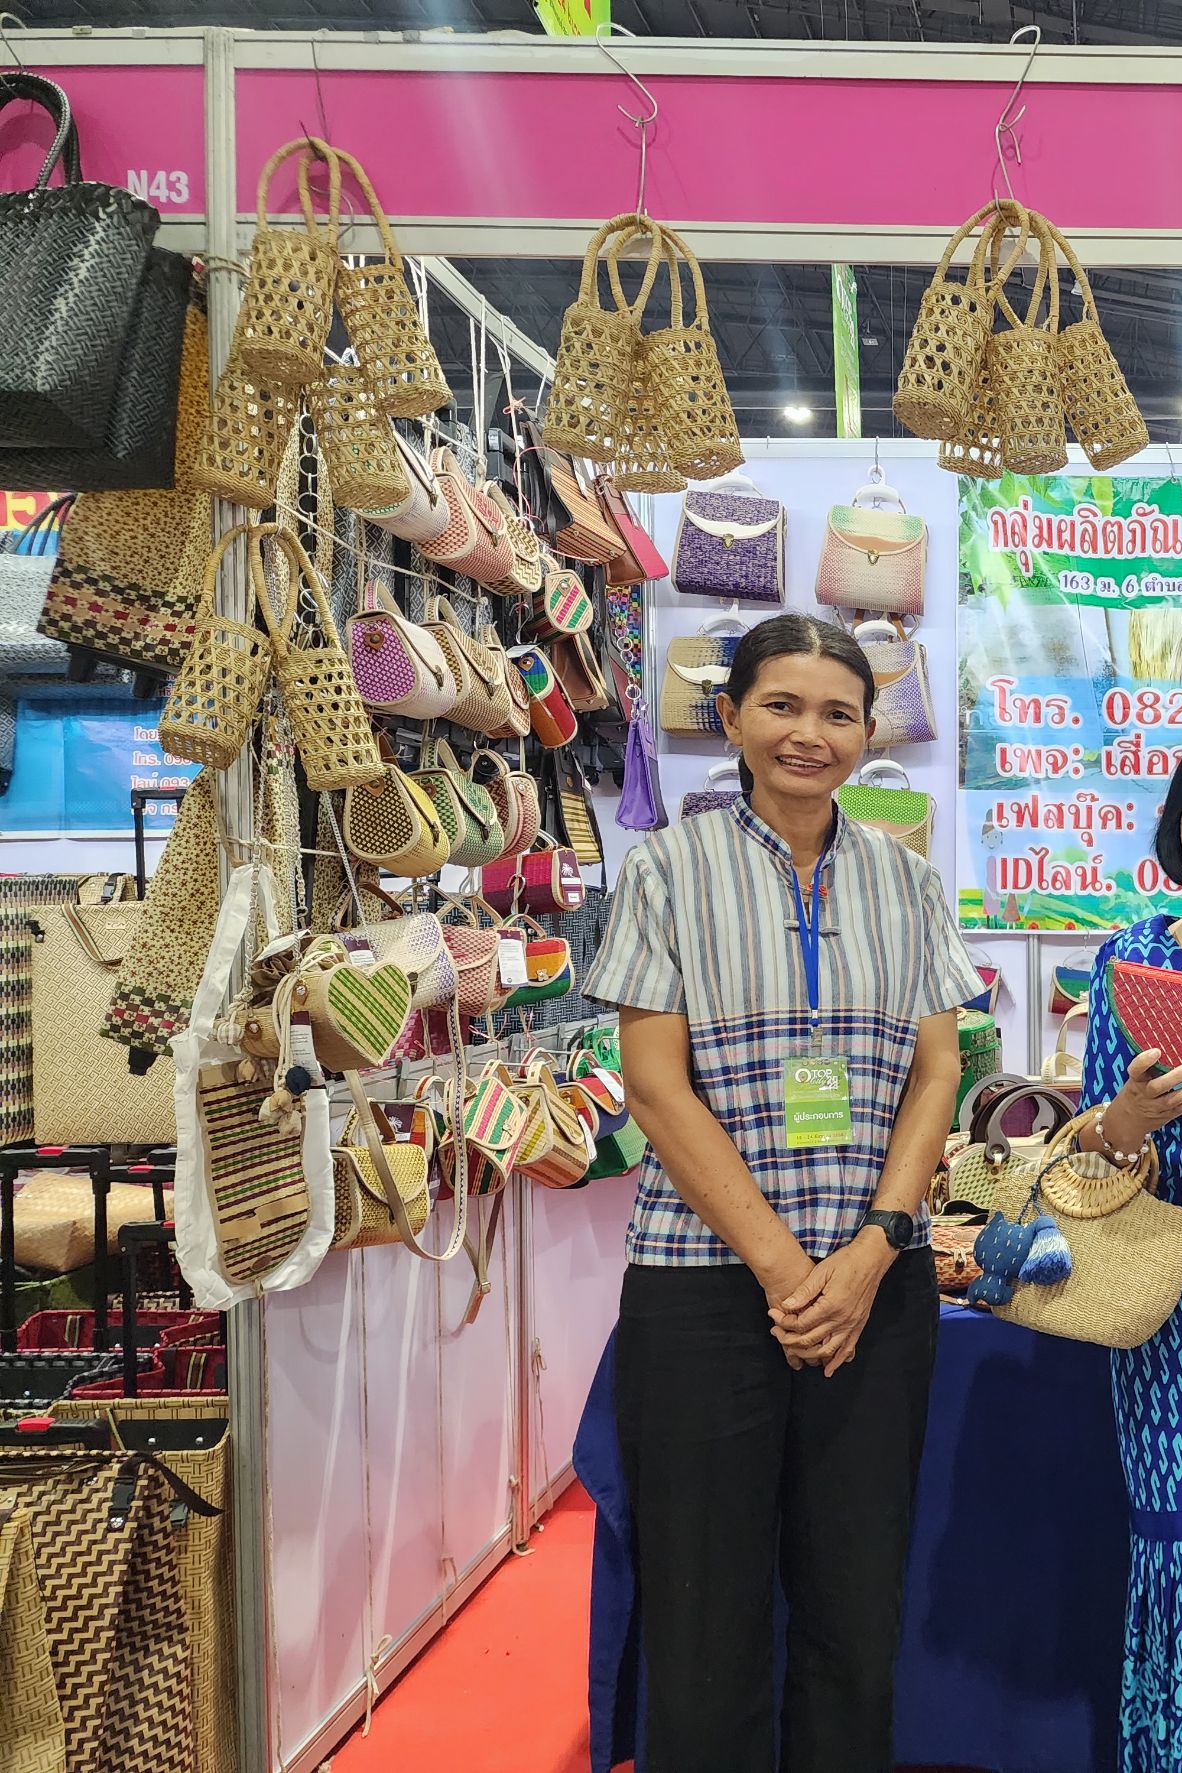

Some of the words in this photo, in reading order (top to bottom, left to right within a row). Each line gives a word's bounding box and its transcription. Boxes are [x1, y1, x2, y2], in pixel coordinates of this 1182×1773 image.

[127, 169, 190, 204] N43
[1061, 573, 1091, 592] 163
[1099, 578, 1116, 593] ม.
[1125, 579, 1136, 594] 6
[991, 677, 1082, 726] โทร.
[998, 745, 1083, 777] เพจ:
[995, 791, 1135, 848] เฟสบุ๊ค:
